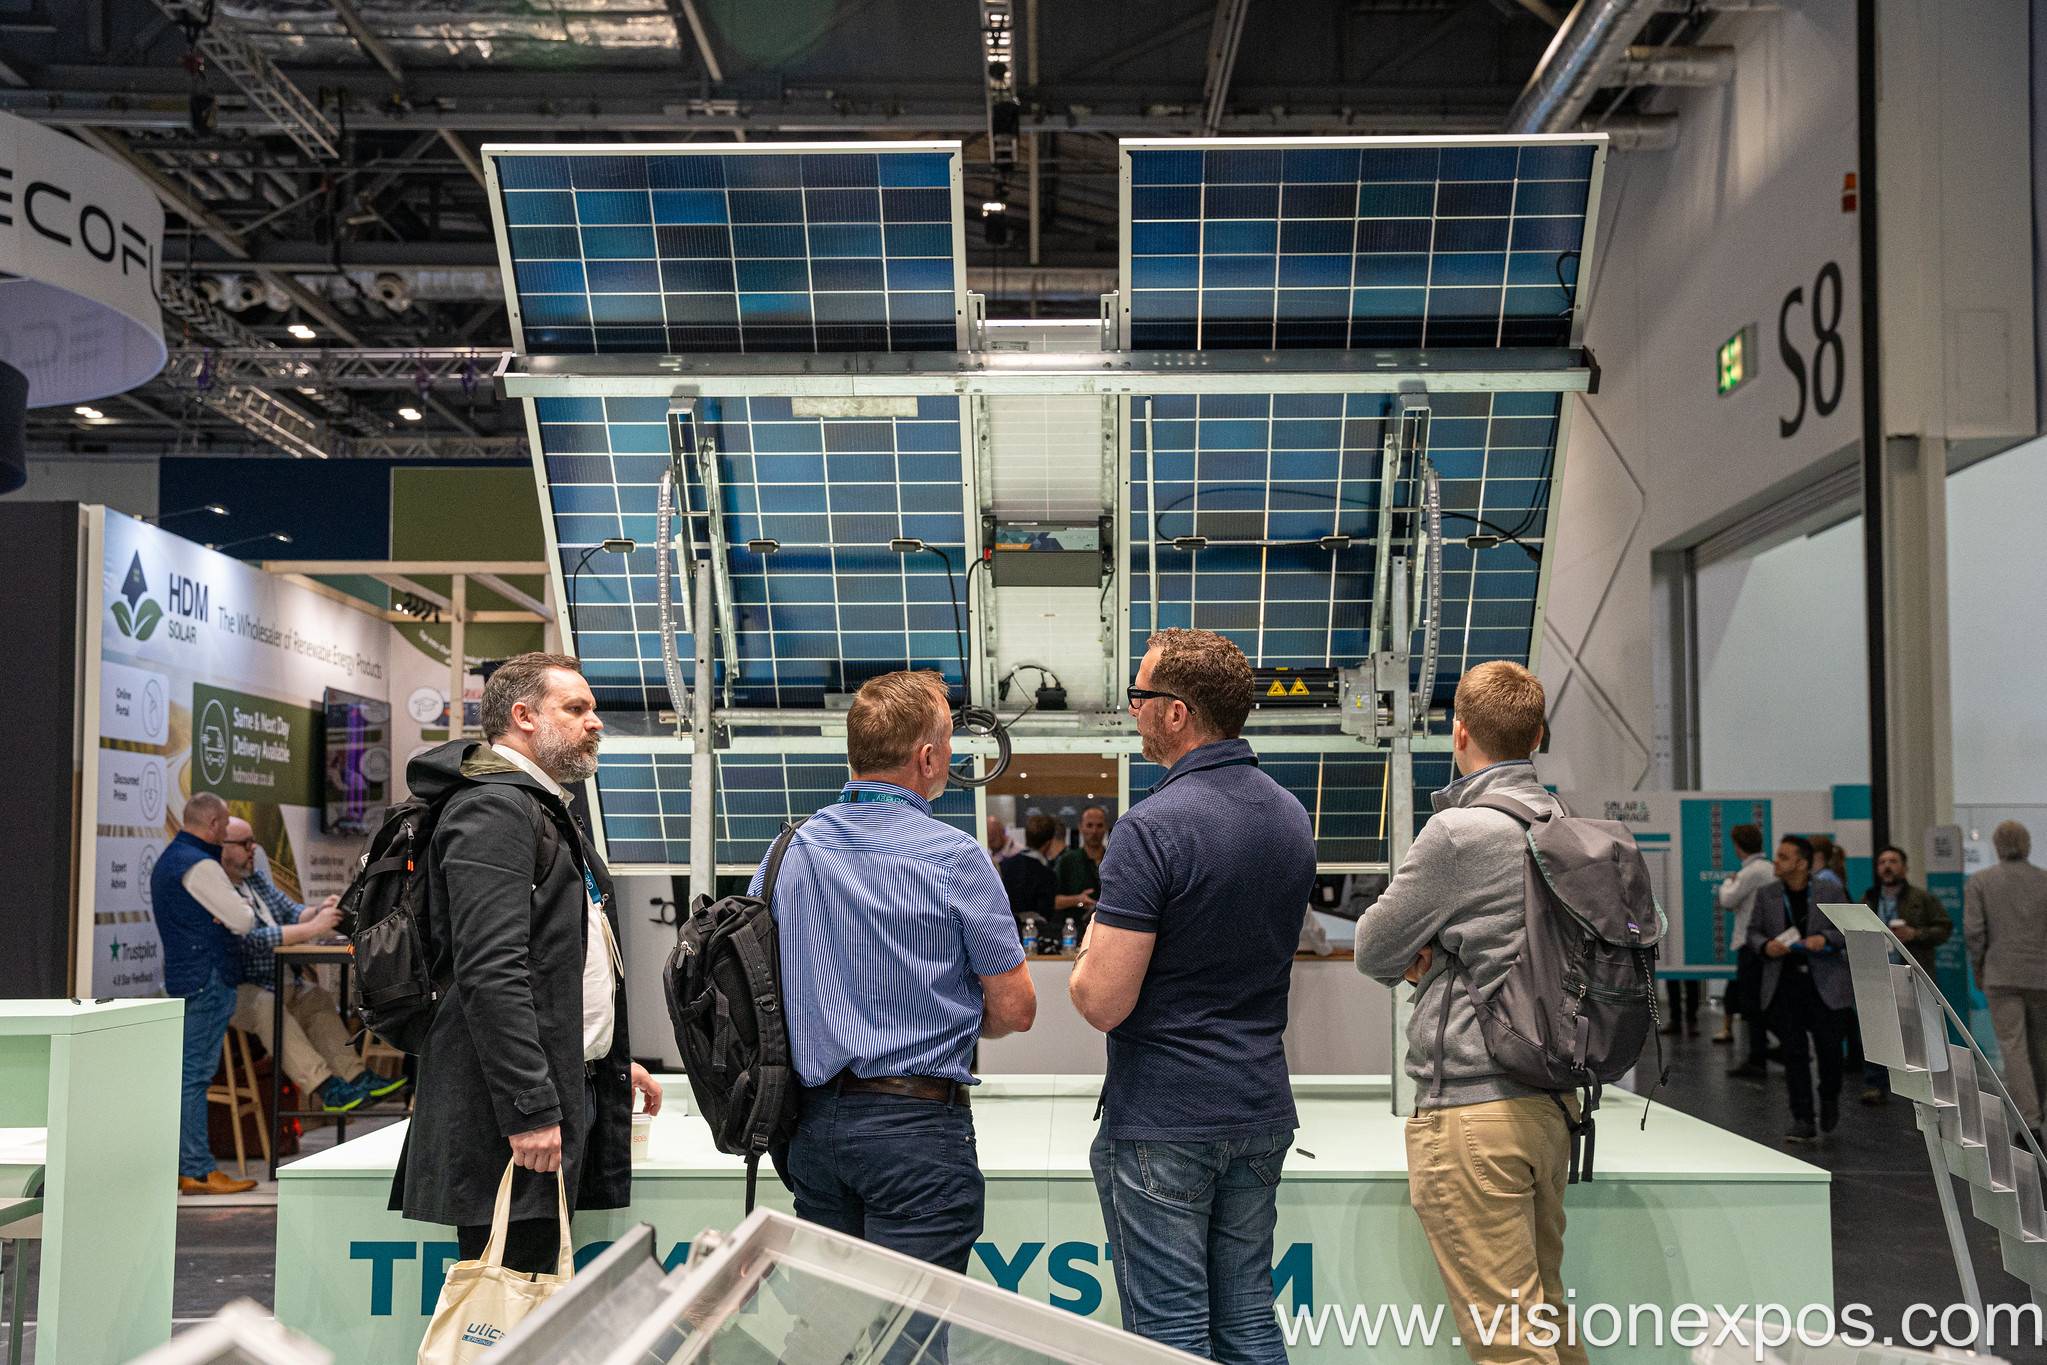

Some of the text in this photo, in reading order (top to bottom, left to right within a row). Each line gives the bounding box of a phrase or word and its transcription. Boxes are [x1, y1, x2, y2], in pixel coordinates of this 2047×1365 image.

[1778, 260, 1844, 439] S8
[168, 572, 209, 623] HDM
[168, 619, 198, 645] SOLAR
[218, 606, 235, 634] The
[236, 611, 283, 649] Wholesaler
[294, 631, 333, 664] Renewable
[333, 644, 355, 677] Energy
[356, 652, 384, 681] Products
[121, 942, 158, 963] Trustpilot
